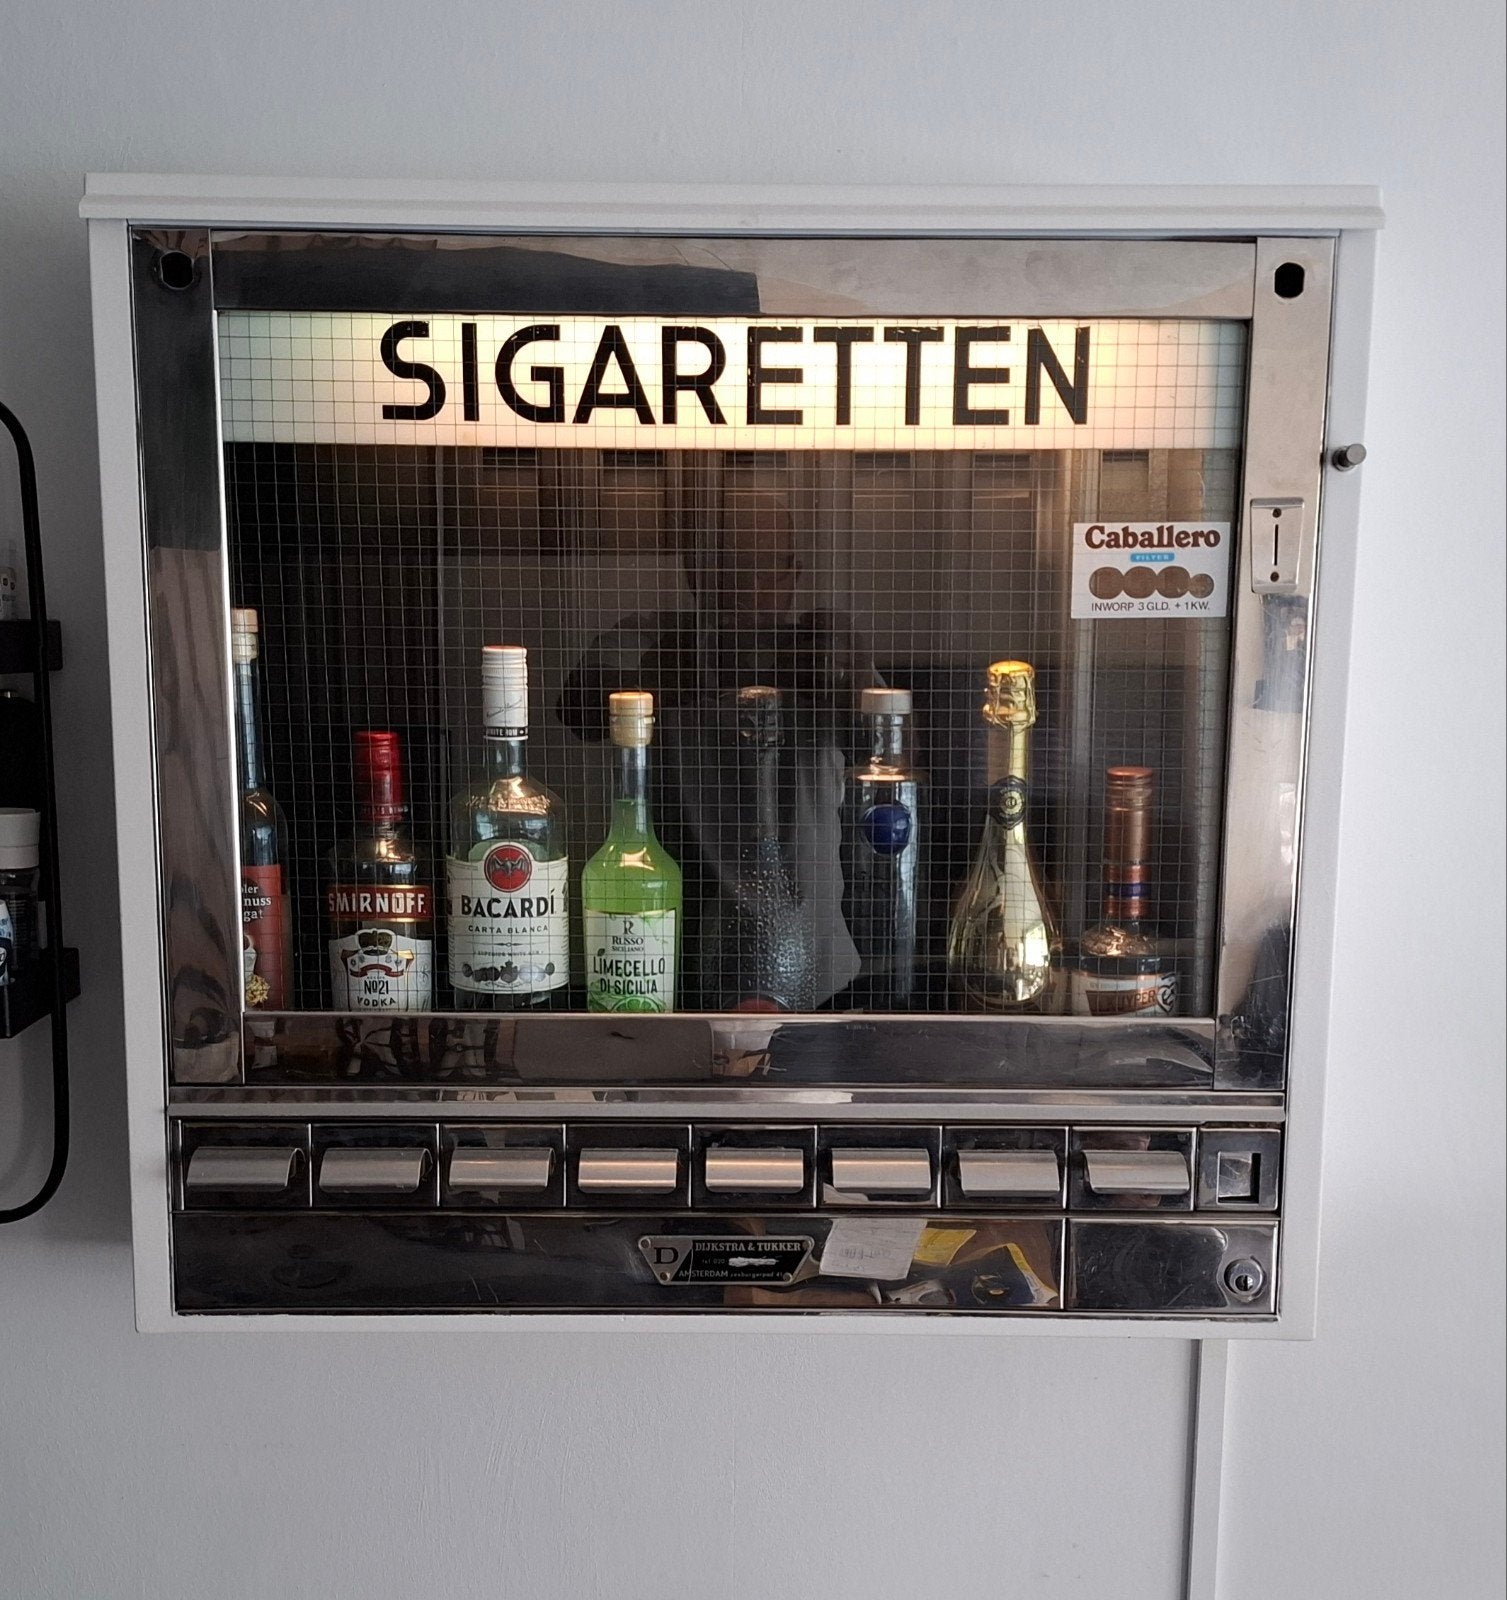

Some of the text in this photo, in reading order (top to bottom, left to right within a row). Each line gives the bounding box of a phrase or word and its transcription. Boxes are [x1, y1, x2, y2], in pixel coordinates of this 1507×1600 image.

[379, 321, 1091, 425] SIGARETTEN
[1085, 525, 1221, 549] Caballero
[1091, 602, 1135, 612] INWORP
[1138, 602, 1145, 611] 3
[328, 892, 424, 913] SMIRNOFF
[461, 888, 555, 918] BACARDÍ
[468, 924, 548, 934] CARTA BLANCA
[593, 956, 666, 977] LIMECELLO
[600, 978, 657, 995] DI SICILIA
[357, 996, 397, 1007] VODKA
[695, 1242, 801, 1251] DIJKSTRA & TUKKER
[653, 1247, 679, 1264] D
[678, 1269, 729, 1277] AMSTERDAM
